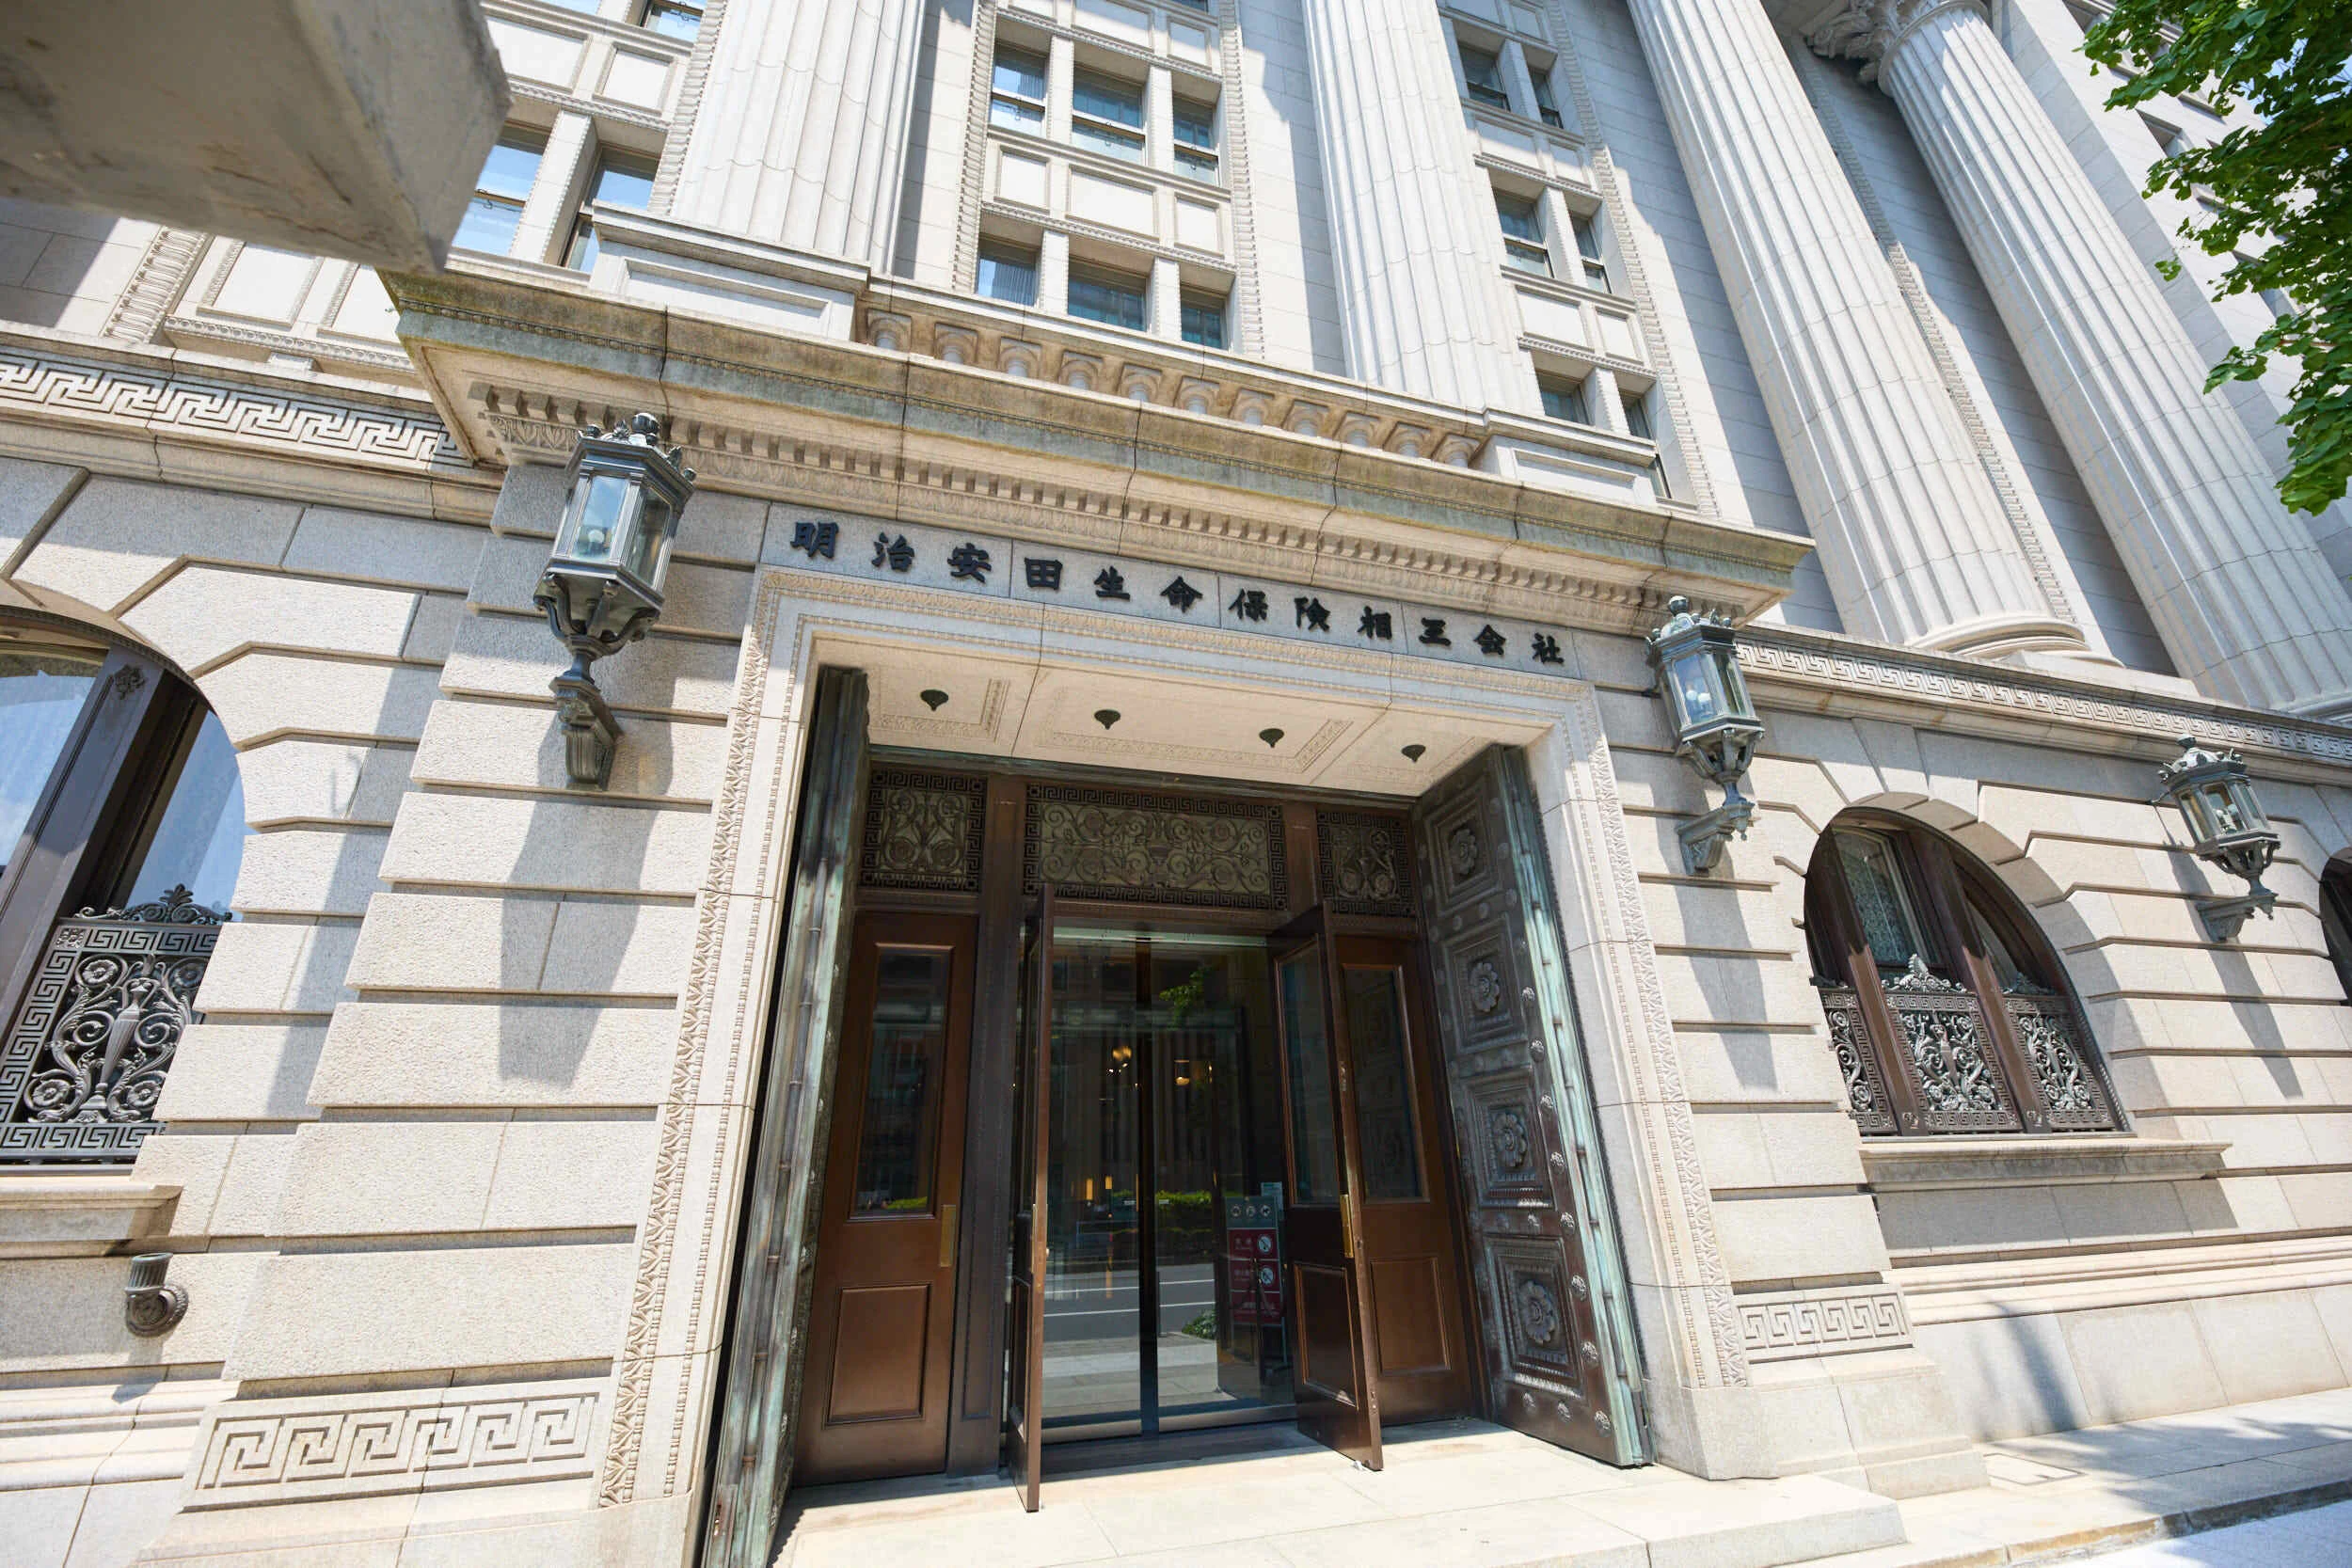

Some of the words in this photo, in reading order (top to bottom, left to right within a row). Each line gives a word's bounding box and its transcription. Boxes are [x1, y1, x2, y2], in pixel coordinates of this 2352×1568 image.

[790, 521, 1565, 664] 明治安田生命保険相互会社
